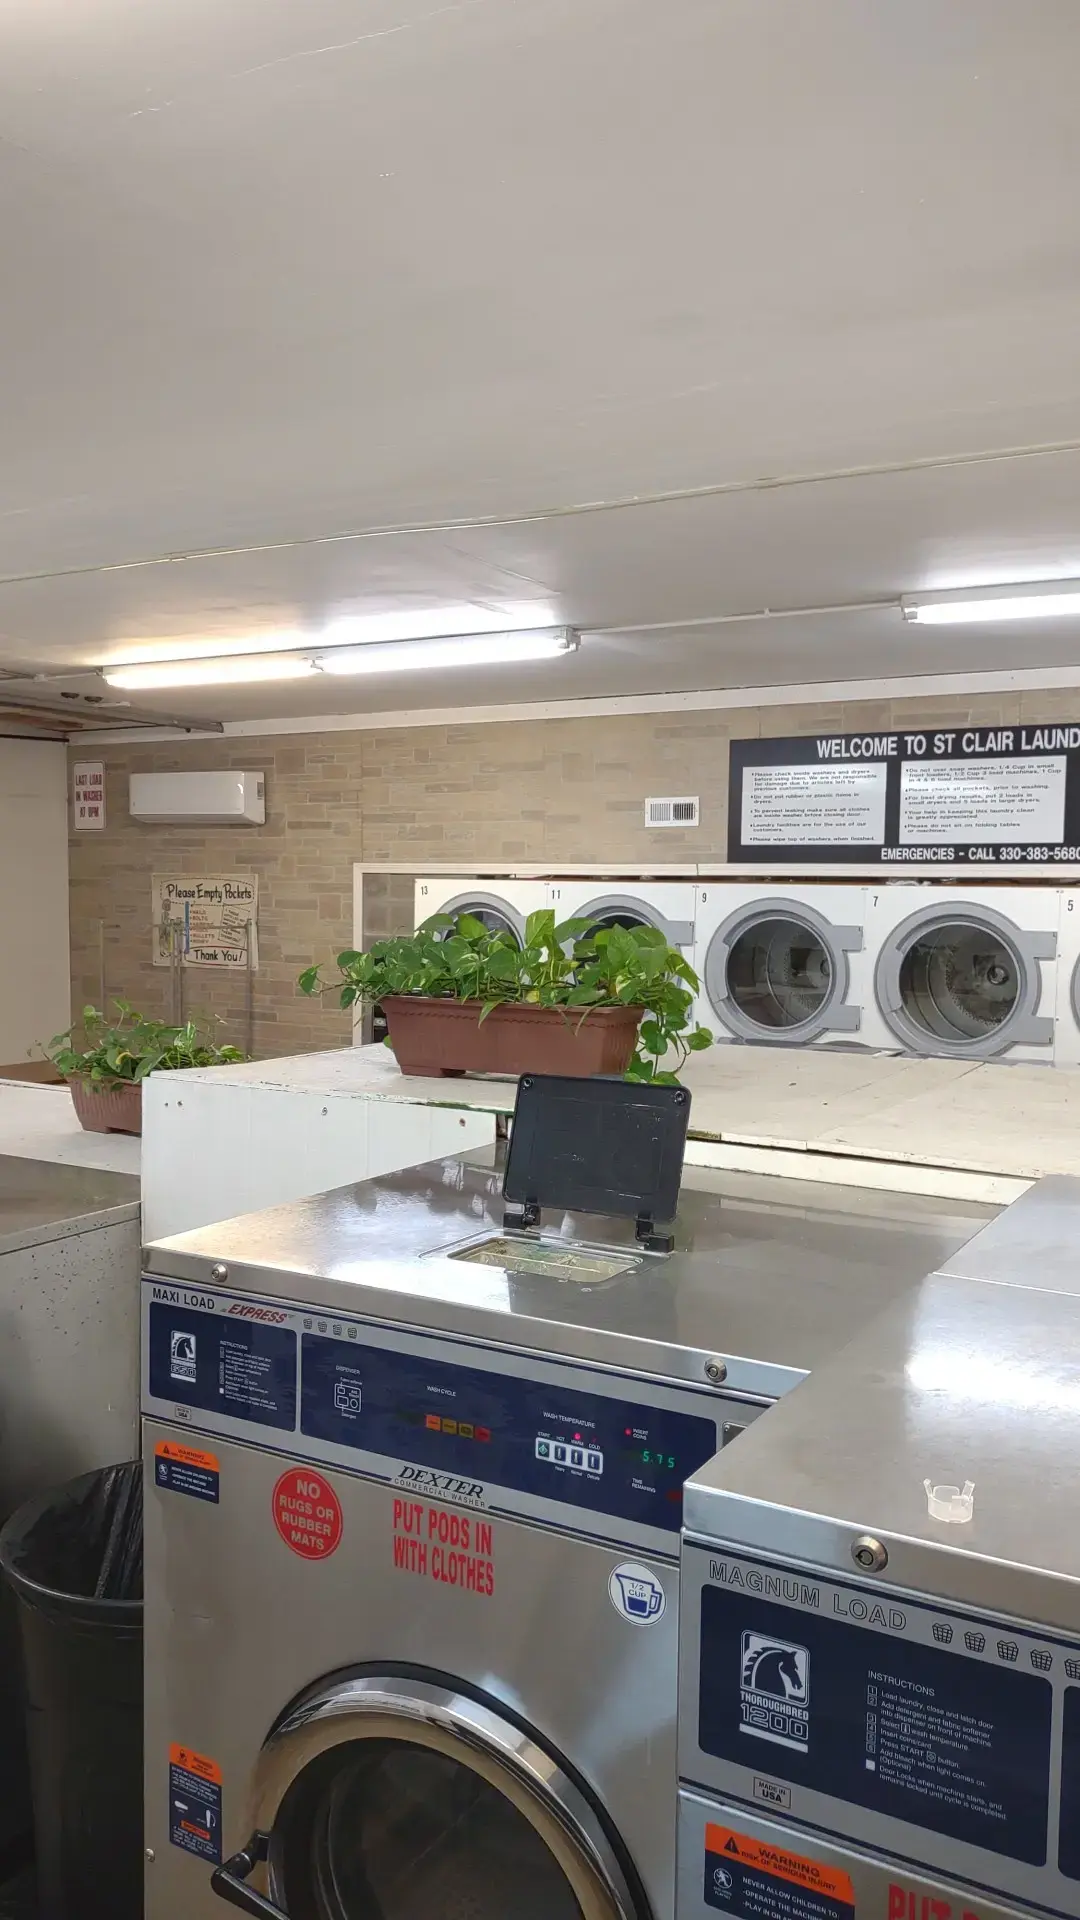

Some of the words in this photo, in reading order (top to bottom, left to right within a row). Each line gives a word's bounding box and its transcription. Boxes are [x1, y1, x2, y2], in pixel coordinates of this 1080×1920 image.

[817, 737, 898, 758] WELCOME
[904, 735, 927, 755] TO
[934, 734, 956, 754] ST
[962, 731, 1014, 752] CLAIR
[1021, 728, 1080, 750] LAUND
[90, 774, 102, 785] LOAD
[880, 848, 955, 860] EMERGENCIES
[968, 848, 996, 860] CALL
[166, 884, 196, 898] Please
[196, 883, 223, 903] Empty
[223, 883, 252, 899] Pockets
[420, 886, 429, 895] 13
[552, 890, 561, 899] 11
[702, 893, 707, 903] 9
[873, 896, 879, 907] 7
[1067, 900, 1074, 911] 5
[194, 950, 219, 961] Thank
[222, 950, 243, 961] You!
[152, 1288, 179, 1303] MAXI
[184, 1294, 215, 1310] LOAD
[227, 1304, 288, 1323] EXPRESS
[543, 1411, 558, 1419] WASH
[559, 1415, 596, 1428] TEMPERATURE
[296, 1479, 321, 1499] NO
[394, 1478, 448, 1498] COMMERCIAL
[451, 1492, 486, 1508] WASHER
[398, 1466, 484, 1499] DEXTER
[279, 1494, 313, 1515] RUGS
[316, 1506, 334, 1522] OR
[281, 1511, 331, 1536] RUBBER
[393, 1499, 424, 1536] PUT
[429, 1508, 470, 1550] PODS
[475, 1522, 492, 1556] IN
[290, 1530, 325, 1550] MATS
[393, 1535, 428, 1575] WITH
[431, 1545, 494, 1596] CLOTHES
[628, 1589, 647, 1598] CUP
[630, 1583, 645, 1591] 1/2
[709, 1560, 820, 1608] MAGNUM
[833, 1593, 907, 1630] LOAD
[867, 1670, 935, 1697] INSTRUCTIONS
[740, 1691, 809, 1721] THOROUGHBRED
[881, 1690, 898, 1701] Load
[926, 1705, 944, 1715] close
[960, 1714, 977, 1725] latch
[740, 1703, 809, 1740] 1200
[881, 1701, 895, 1710] Add
[895, 1706, 927, 1721] detergent
[928, 1716, 941, 1724] and
[943, 1720, 961, 1730] fabric
[963, 1726, 990, 1739] softener
[881, 1709, 893, 1717] into
[894, 1713, 926, 1727] dispenser
[937, 1725, 953, 1736] front
[881, 1718, 900, 1729] Select
[911, 1728, 928, 1738] wash
[880, 1728, 898, 1739] Insert
[880, 1738, 899, 1749] Press
[900, 1745, 925, 1756] START
[880, 1748, 894, 1757] Add
[894, 1753, 916, 1764] bleach
[917, 1761, 936, 1772] when
[936, 1765, 951, 1777] light
[952, 1772, 975, 1784] comes
[758, 1781, 777, 1794] MADE
[778, 1787, 786, 1795] IN
[762, 1790, 782, 1803] USA
[879, 1765, 895, 1775] Door
[896, 1771, 916, 1782] Locks
[917, 1779, 936, 1789] when
[936, 1785, 965, 1799] machine
[988, 1802, 1003, 1811] and
[879, 1773, 905, 1786] remains
[906, 1781, 929, 1794] locked
[944, 1795, 962, 1805] cycle
[740, 1851, 758, 1861] RISK
[773, 1862, 807, 1881] SERIOUS
[808, 1876, 837, 1891] INJURY
[758, 1847, 820, 1878] WARNING
[742, 1876, 766, 1890] NEVER
[766, 1886, 791, 1900] ALLOW
[791, 1895, 828, 1915] CHILDREN
[828, 1909, 838, 1918] TO
[762, 1907, 770, 1915] IN
[777, 1902, 792, 1913] THE
[792, 1908, 823, 1920] MACHIN
